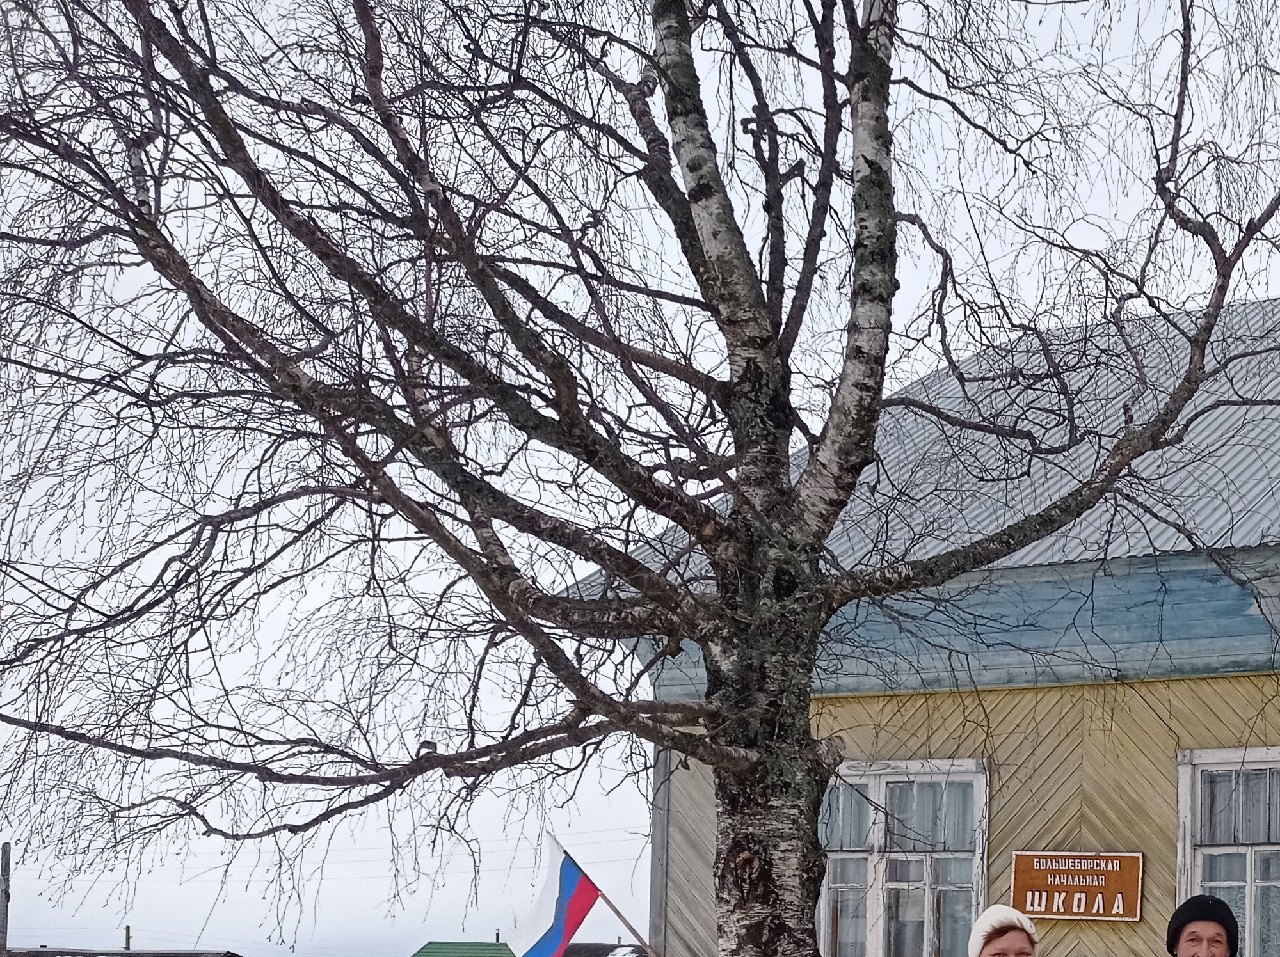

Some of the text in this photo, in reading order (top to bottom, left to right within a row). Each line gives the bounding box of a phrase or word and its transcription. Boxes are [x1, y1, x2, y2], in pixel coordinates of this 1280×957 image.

[1034, 858, 1120, 871] БОЛЬШЕБОРСКАЯ
[1048, 874, 1105, 886] НАЧАЛЬНАЯ
[1026, 891, 1124, 914] ШКОЛА
